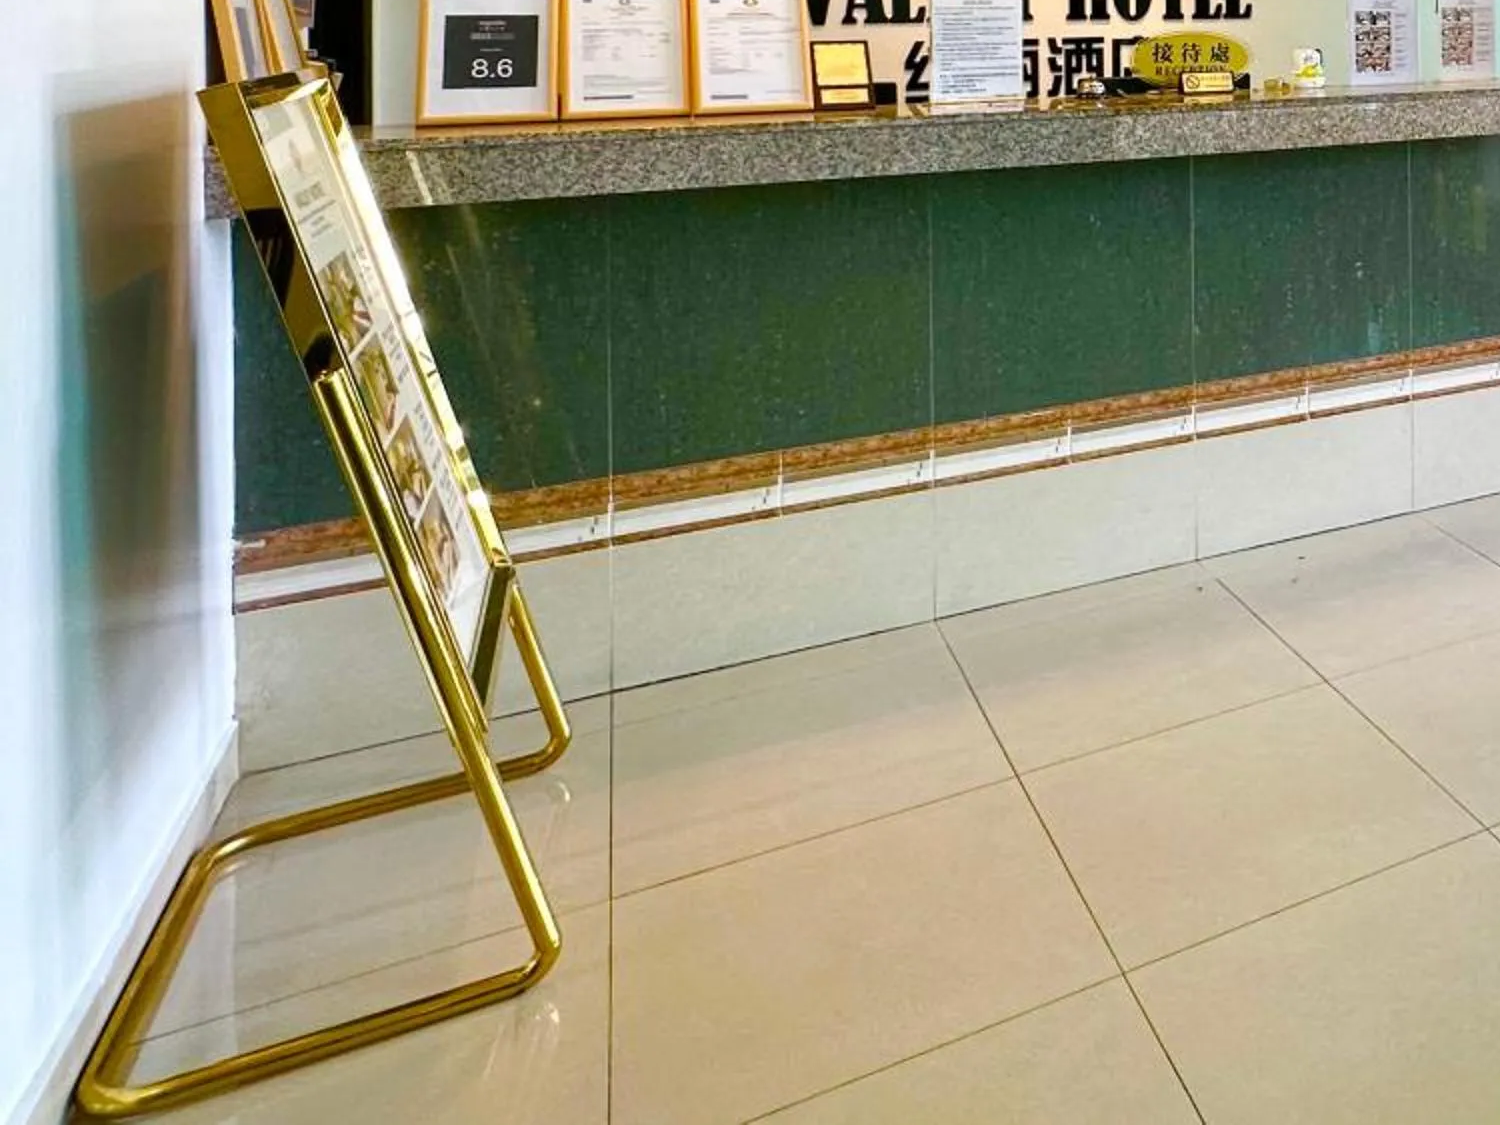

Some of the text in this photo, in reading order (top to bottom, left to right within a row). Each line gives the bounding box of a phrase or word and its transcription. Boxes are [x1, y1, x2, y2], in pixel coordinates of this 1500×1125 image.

[1151, 41, 1230, 64] 接待處
[471, 58, 513, 78] 8.6
